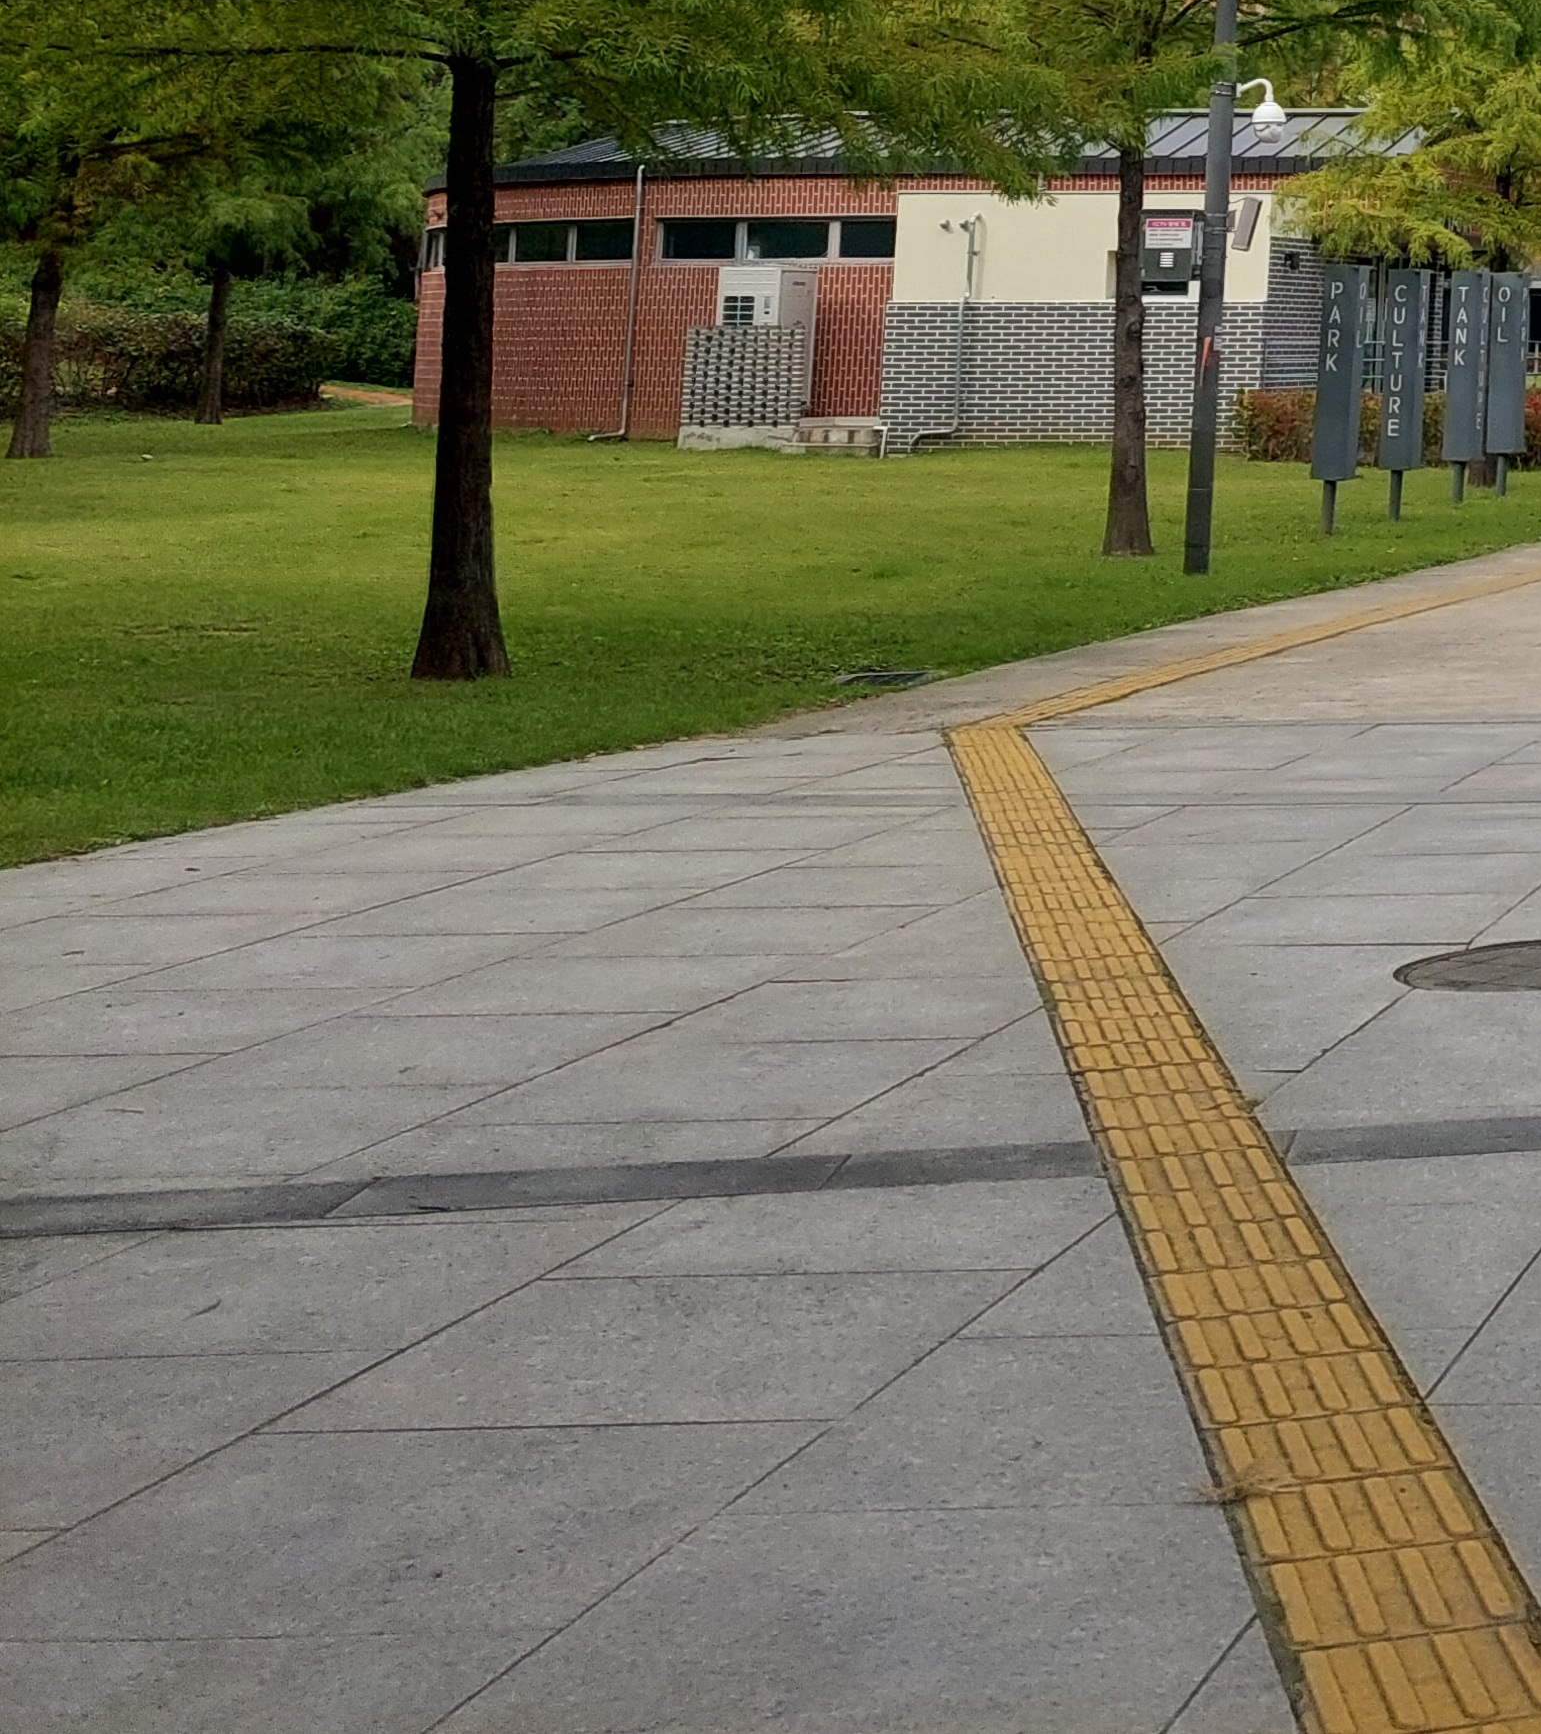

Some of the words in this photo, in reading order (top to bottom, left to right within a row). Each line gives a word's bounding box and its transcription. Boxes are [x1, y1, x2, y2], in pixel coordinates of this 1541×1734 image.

[1325, 281, 1344, 372] PARK
[1356, 282, 1368, 349] OIL
[1417, 284, 1428, 369] TANK
[1454, 286, 1470, 366] TANK
[1497, 286, 1511, 343] OIL
[1387, 284, 1408, 437] CULTURE
